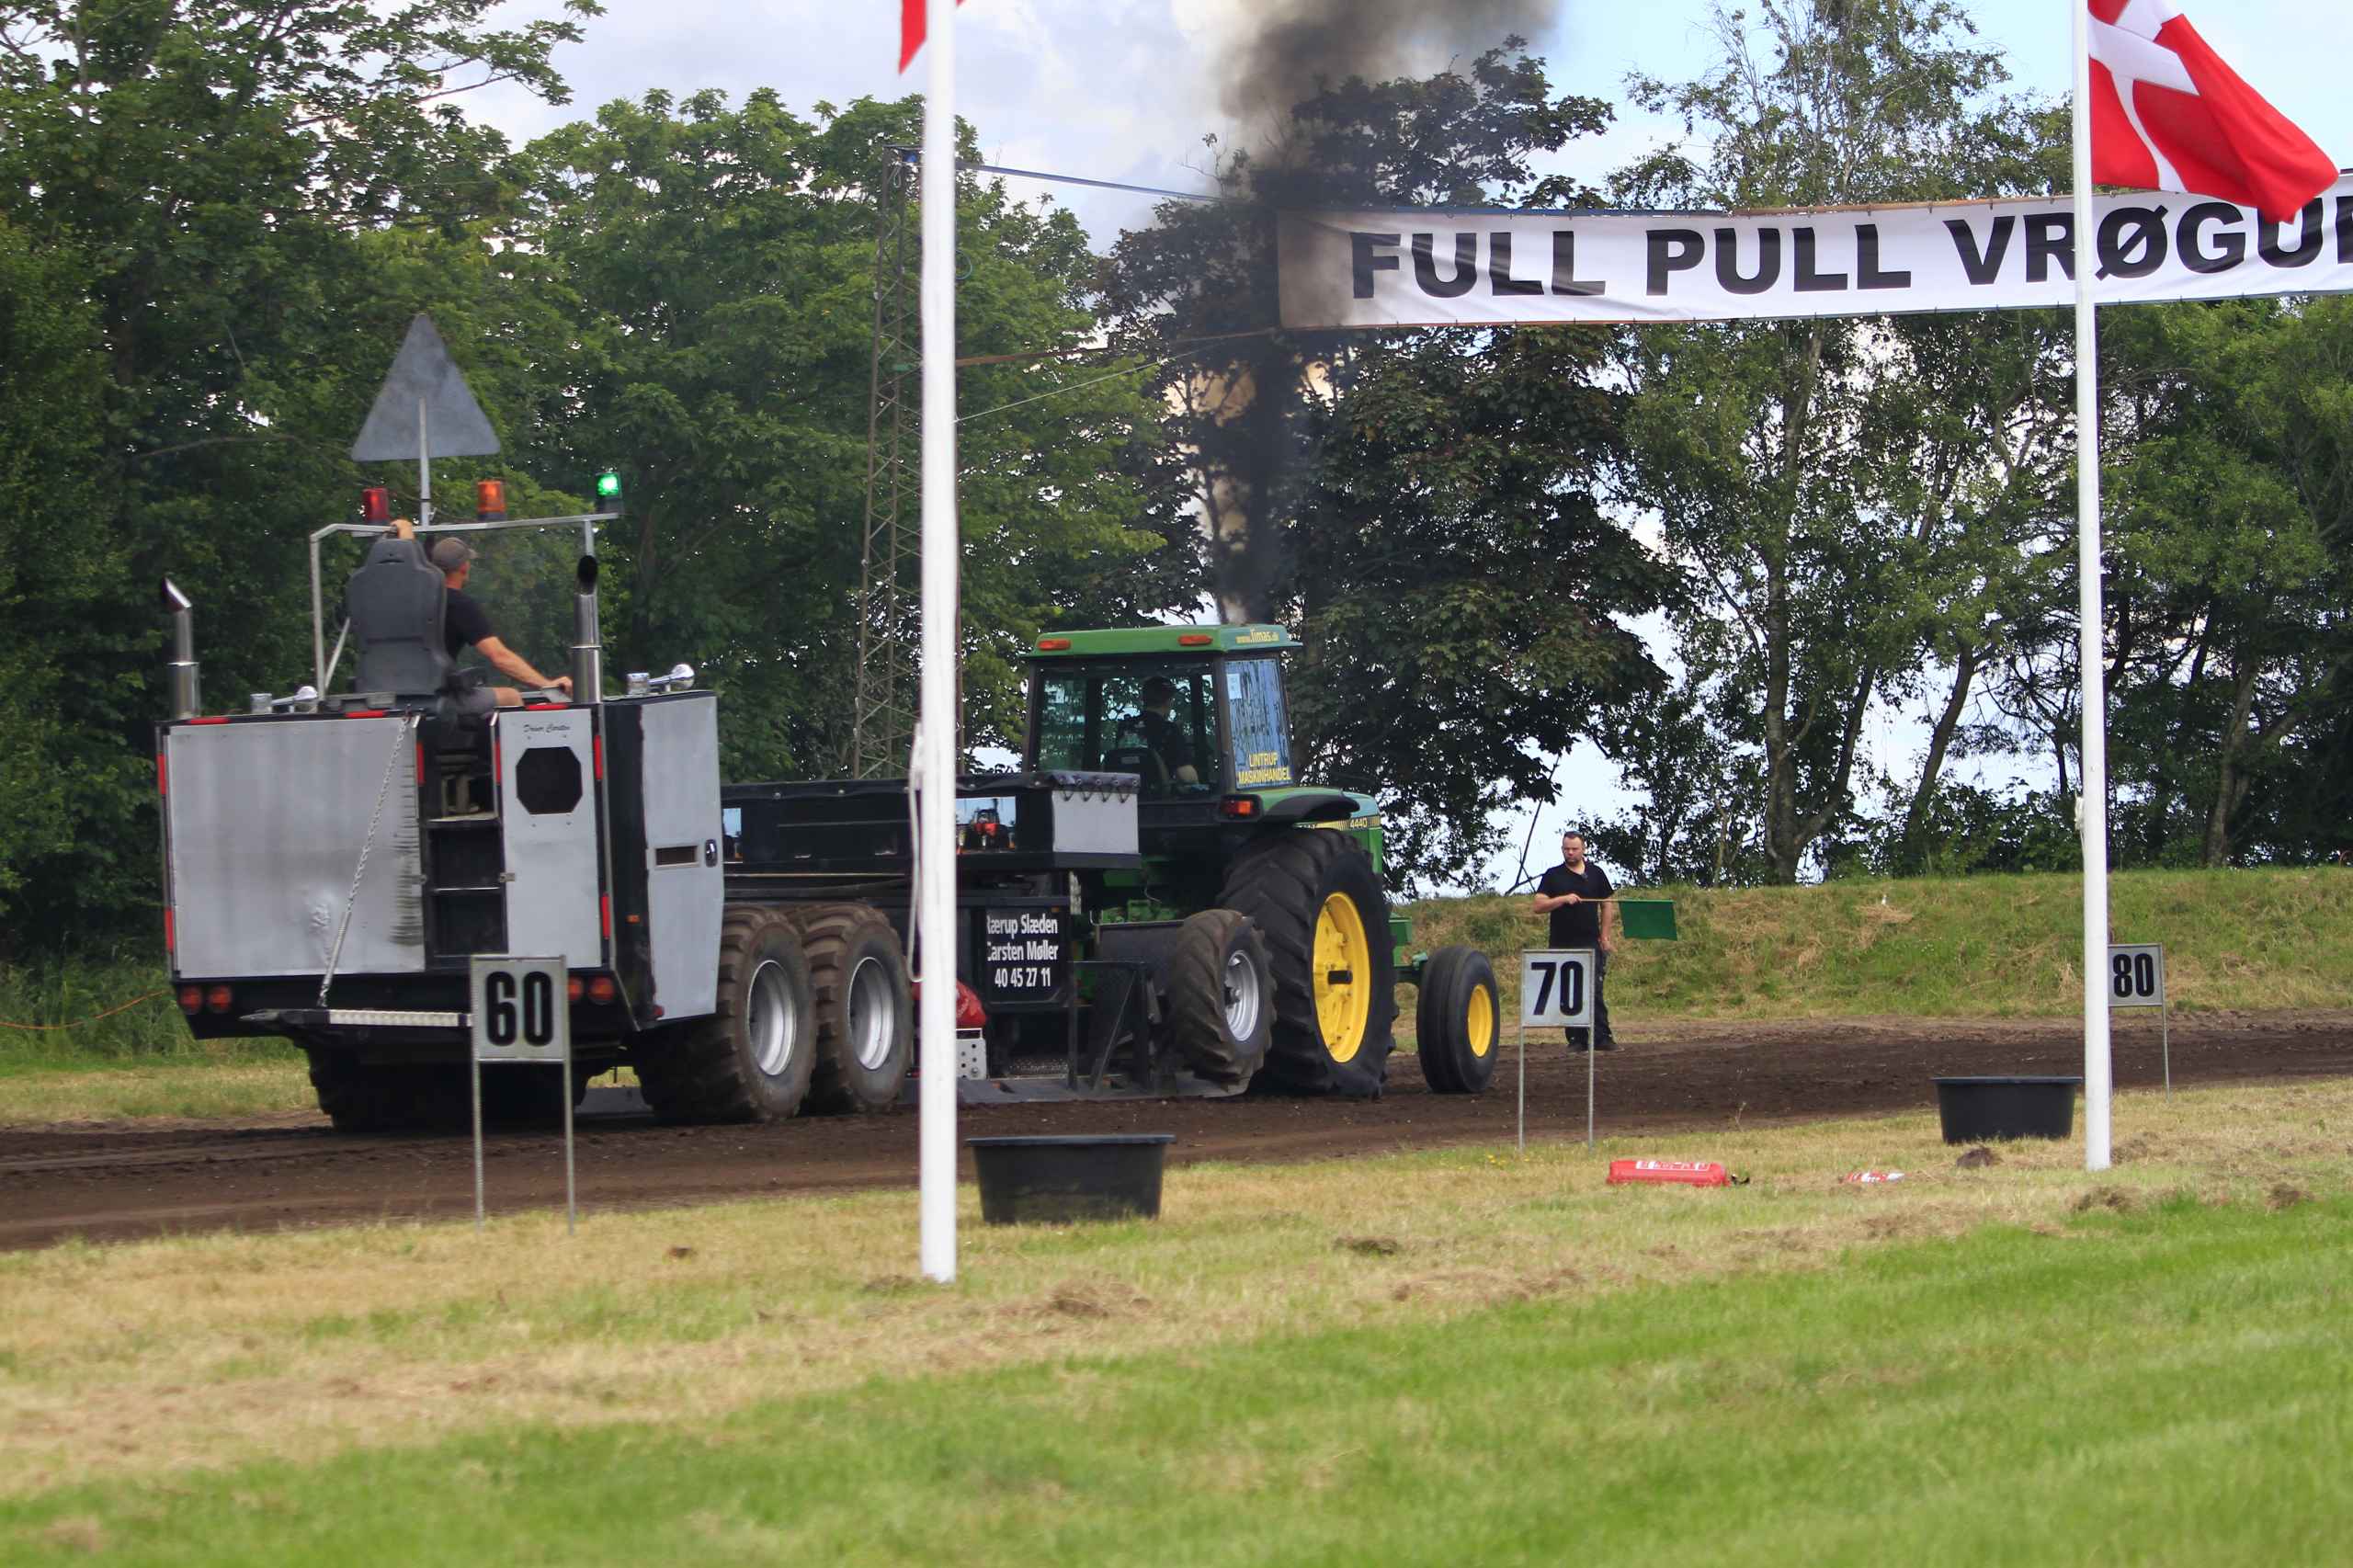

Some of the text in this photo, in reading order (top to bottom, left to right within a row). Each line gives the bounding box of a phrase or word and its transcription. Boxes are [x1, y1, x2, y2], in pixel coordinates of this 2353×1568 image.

[1350, 195, 2353, 300] FULL PULL VRØGU
[1020, 913, 1058, 934] Slæden
[1026, 939, 1059, 960] Møller
[995, 967, 1051, 988] 40 45 27 11
[1530, 960, 1584, 1017] 70
[2112, 952, 2154, 998] 80
[485, 971, 554, 1048] 60
